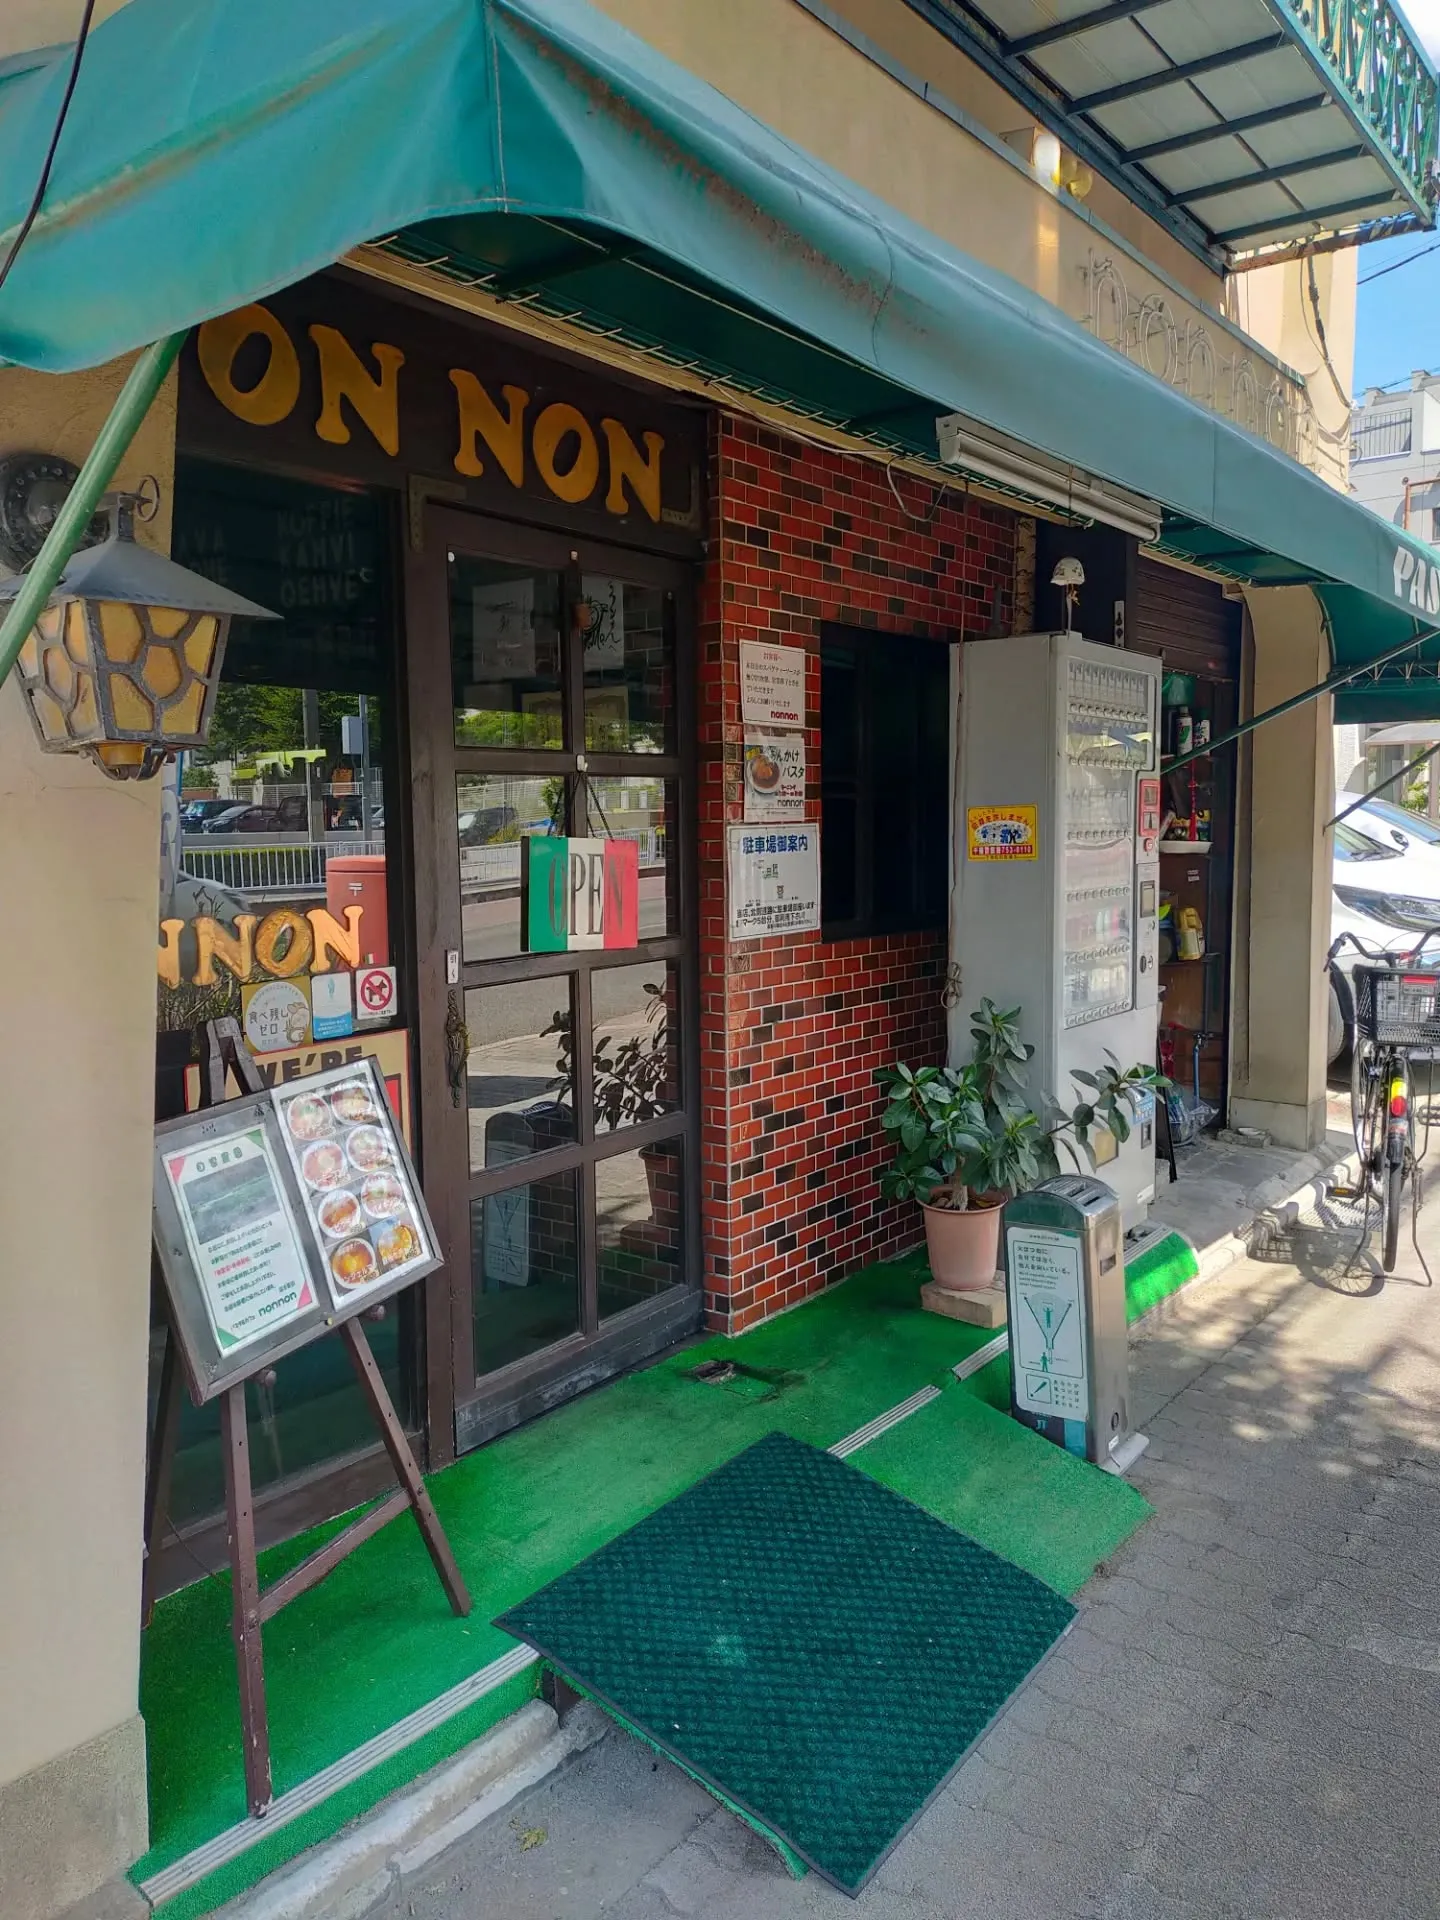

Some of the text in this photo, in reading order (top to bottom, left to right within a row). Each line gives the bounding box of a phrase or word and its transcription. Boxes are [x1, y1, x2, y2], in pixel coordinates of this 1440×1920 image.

[449, 367, 665, 523] NON
[770, 710, 799, 721] nonnon
[782, 765, 804, 779] パスタ
[742, 834, 809, 855] 駐車場御案内
[548, 853, 627, 937] OPEN
[248, 1007, 289, 1025] 食べ残し
[259, 1023, 278, 1037] ゼロ
[258, 1291, 297, 1317] nonnon
